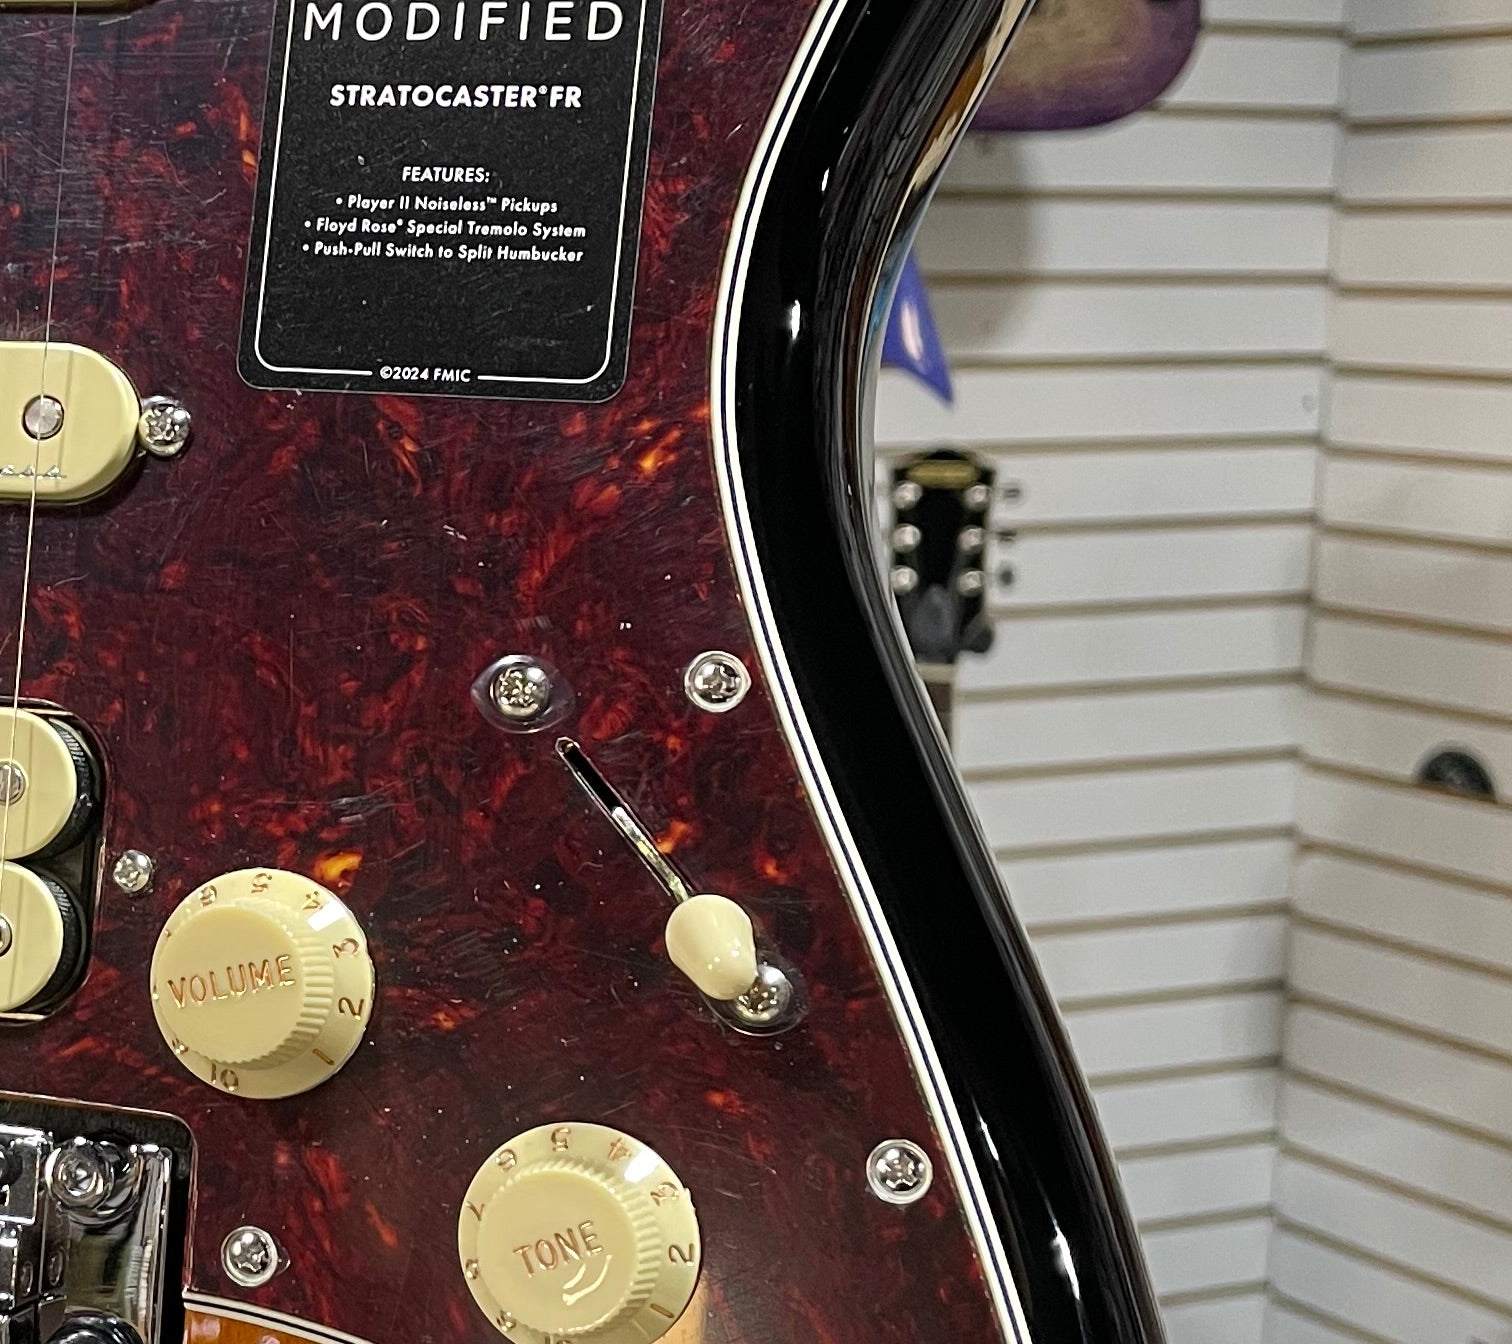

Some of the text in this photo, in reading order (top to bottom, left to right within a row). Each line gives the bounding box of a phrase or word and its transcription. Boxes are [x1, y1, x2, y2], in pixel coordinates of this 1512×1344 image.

[303, 1, 624, 42] MODIFIED
[402, 166, 490, 183] FEATURES:
[347, 194, 395, 213] Player
[399, 195, 411, 211] II
[501, 197, 558, 215] Pickups
[316, 218, 358, 236] Floyd
[407, 219, 464, 237] Special
[467, 221, 528, 238] Tremolo
[532, 222, 587, 240] System
[314, 241, 584, 264] Push-Pull Switch to Split Humbucker
[433, 367, 472, 383] FMIC
[168, 954, 296, 1009] VOLUME
[513, 1220, 603, 1277] TONE
